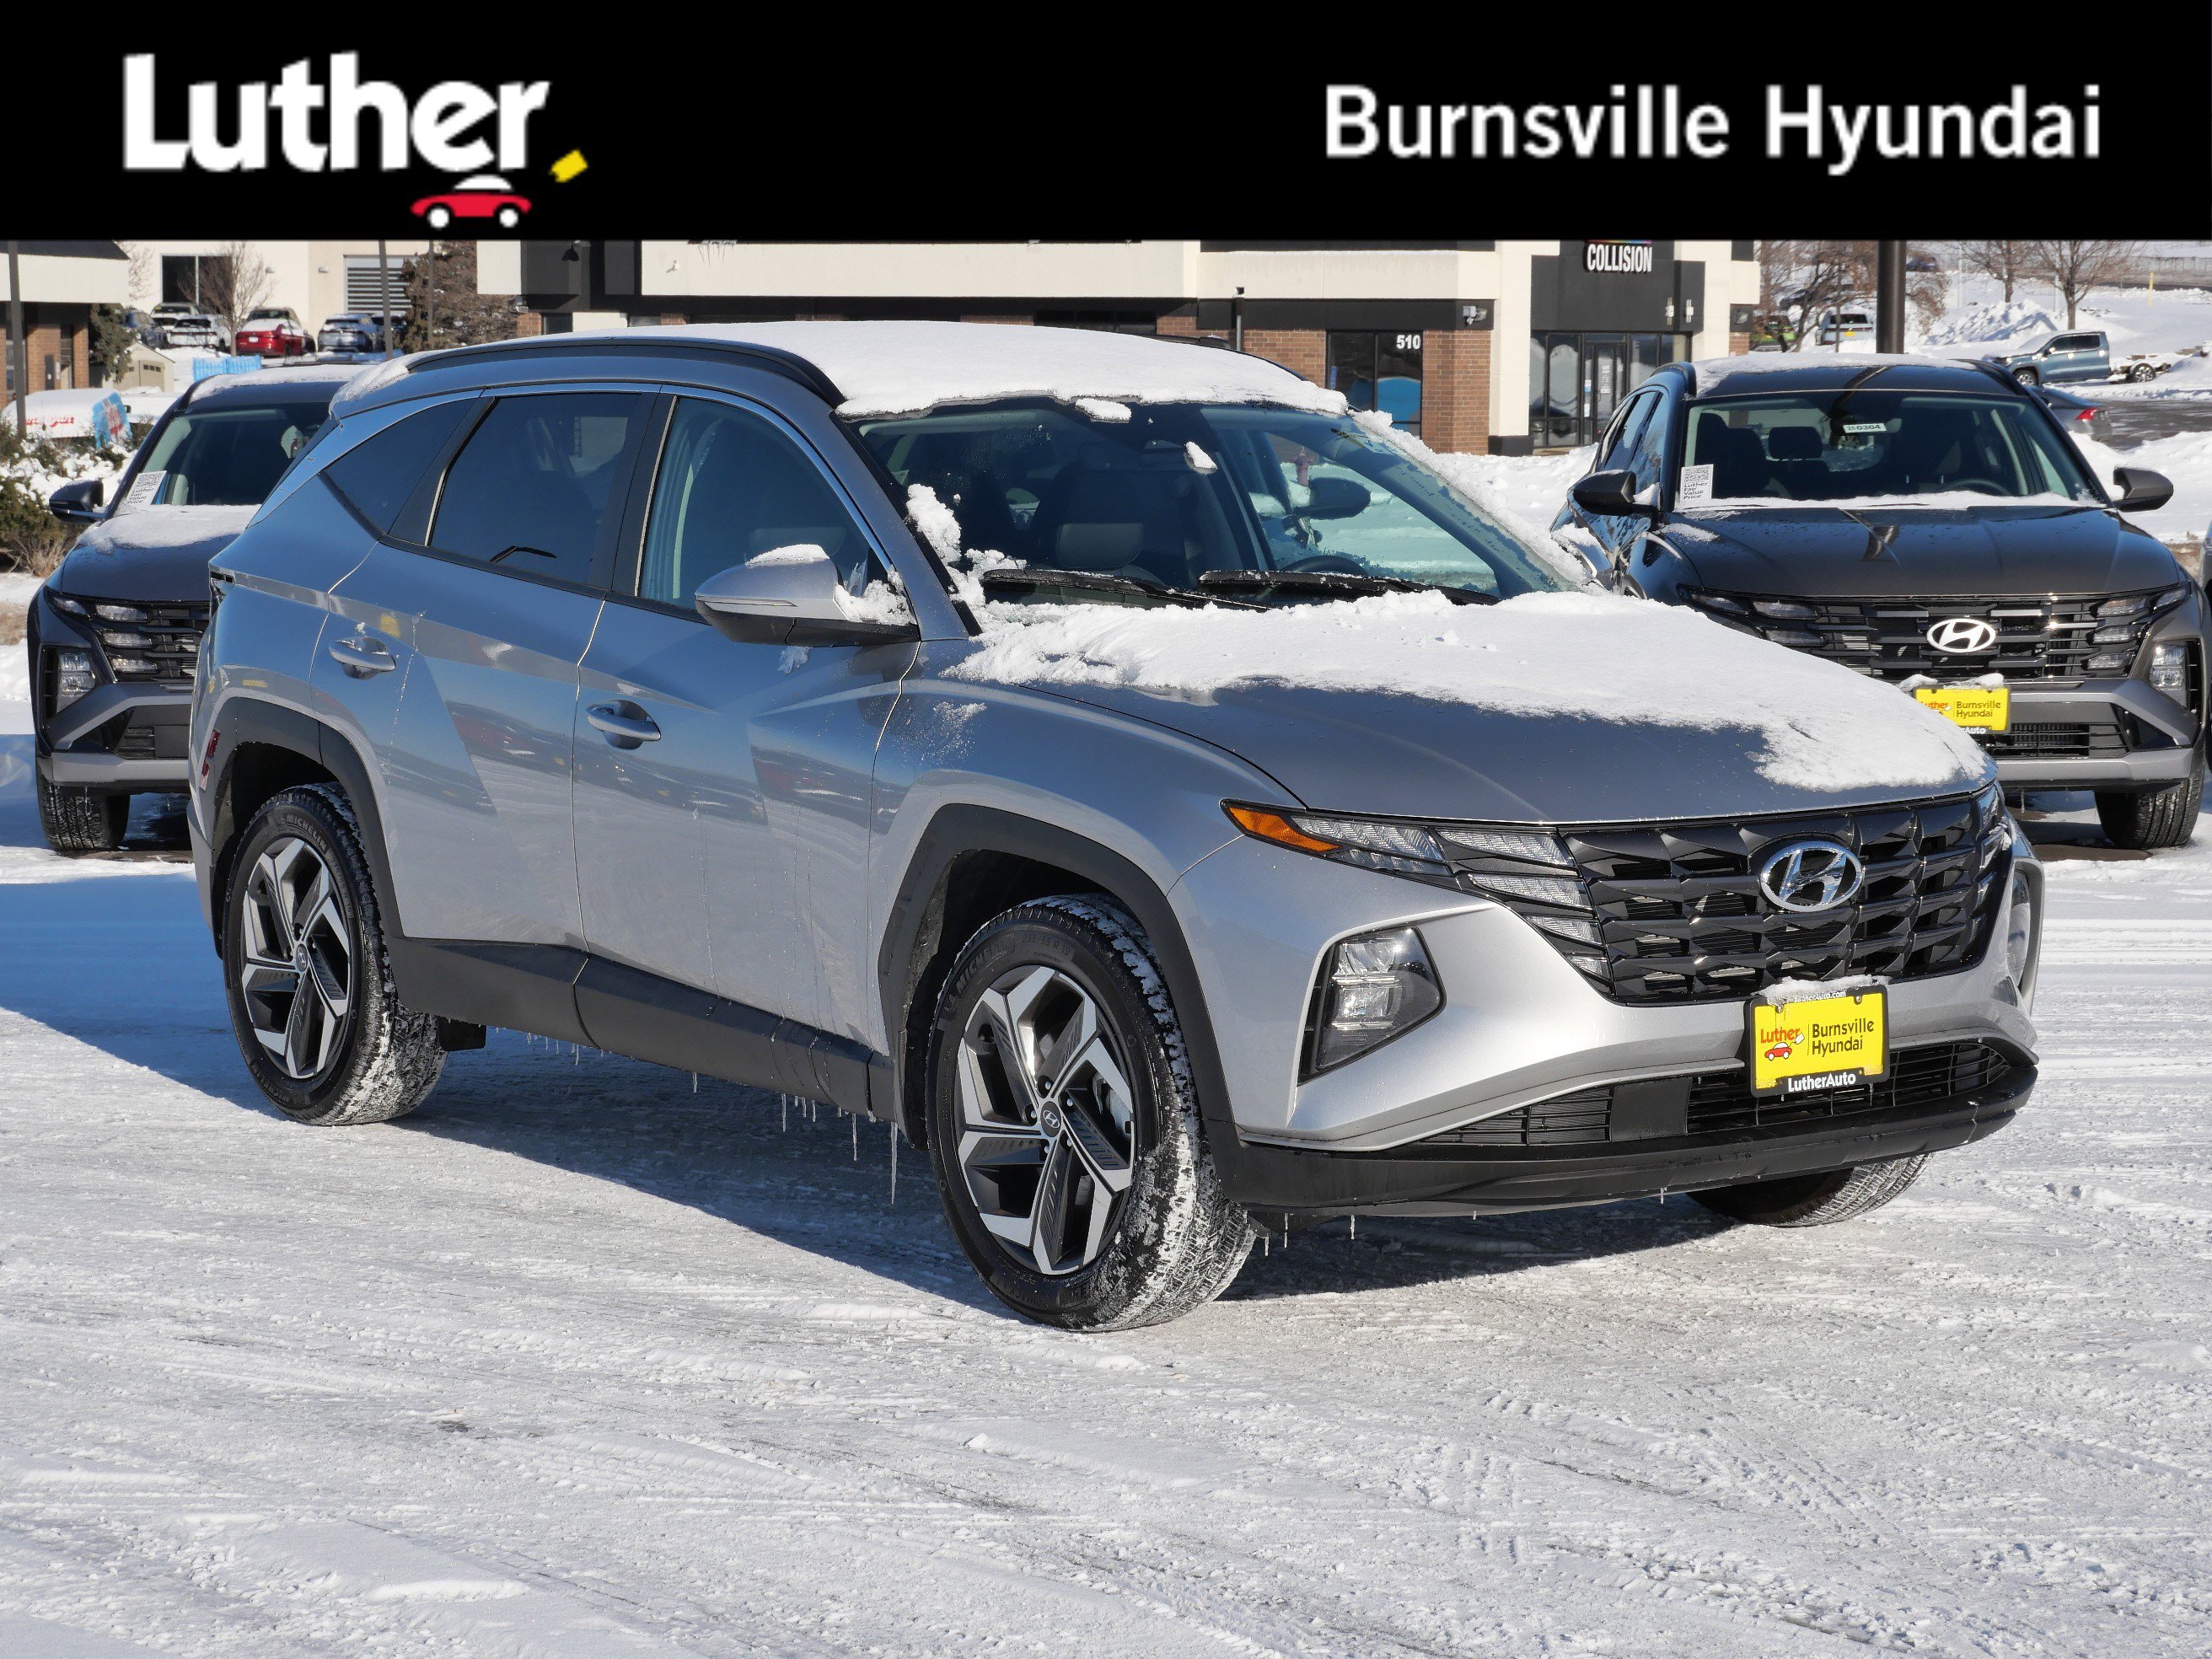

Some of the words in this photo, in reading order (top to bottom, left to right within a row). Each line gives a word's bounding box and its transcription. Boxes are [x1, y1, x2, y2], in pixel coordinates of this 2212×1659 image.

[1587, 244, 1652, 272] COLLISION
[1396, 334, 1421, 349] 510
[1957, 701, 2001, 709] Burnsville
[1957, 710, 1993, 719] Hyundai
[1760, 1028, 1801, 1044] Luther
[1812, 1018, 1874, 1038] Burnsville
[1812, 1035, 1863, 1057] Hyundai
[1788, 1072, 1856, 1093] LutherAuto
